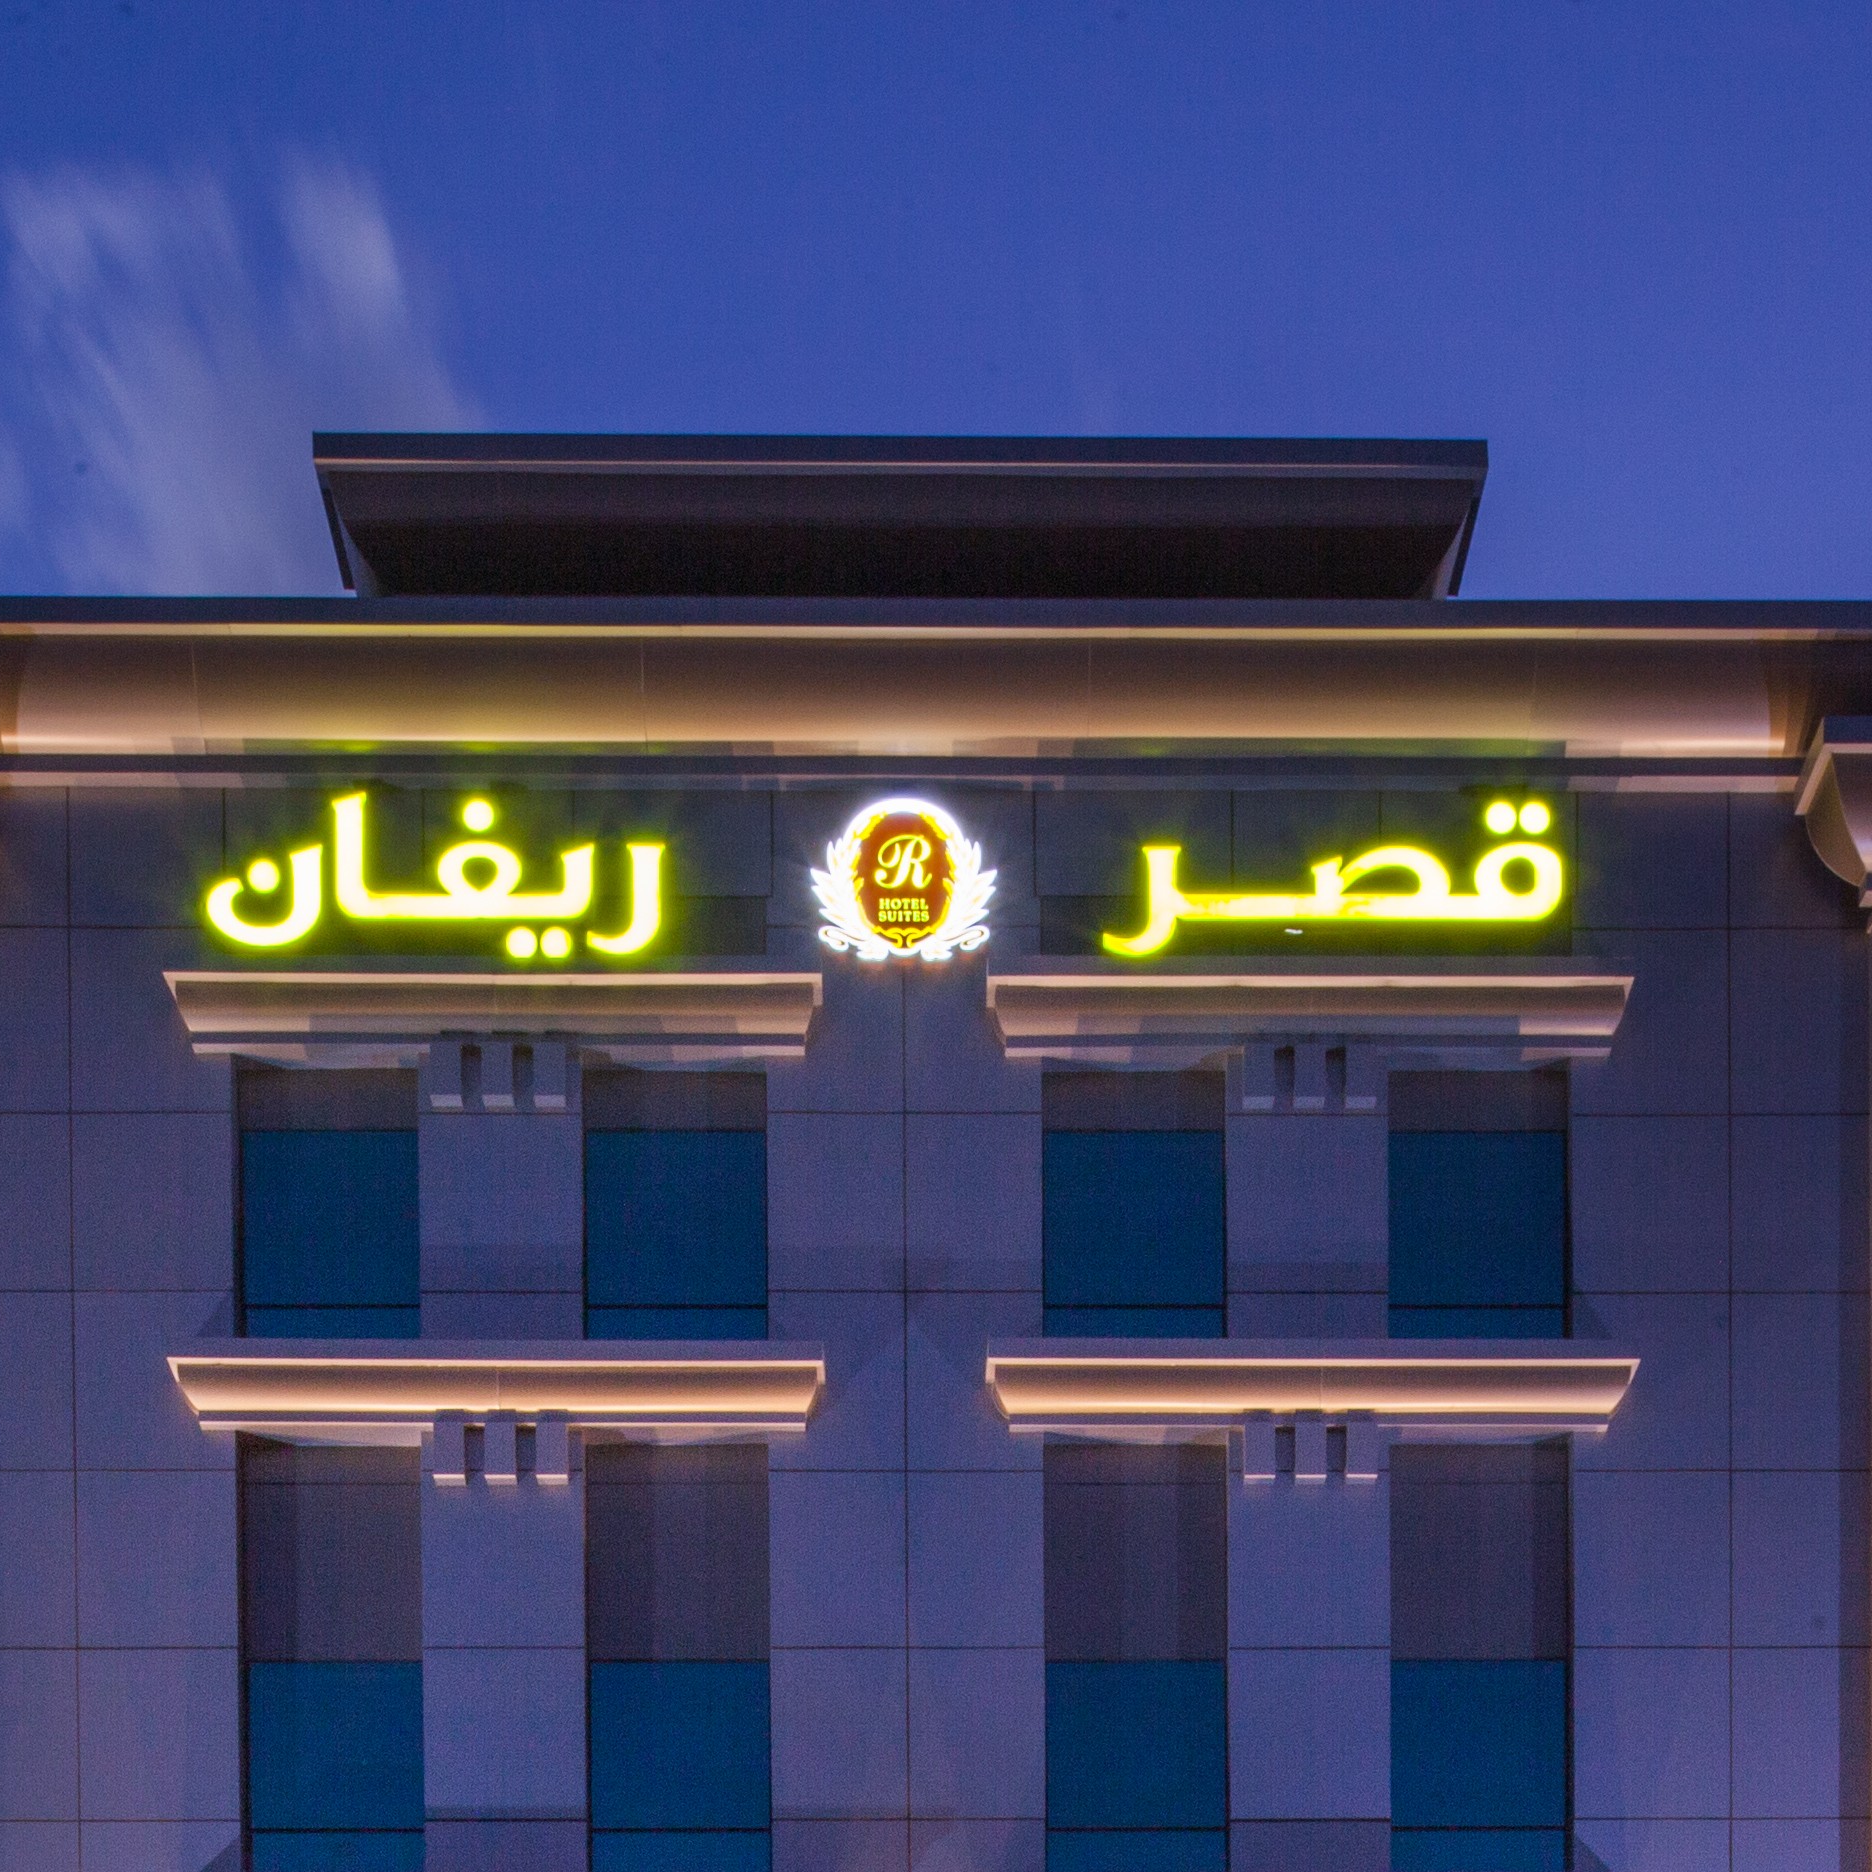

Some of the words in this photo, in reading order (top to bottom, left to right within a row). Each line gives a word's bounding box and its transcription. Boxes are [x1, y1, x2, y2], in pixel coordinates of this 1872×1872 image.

[204, 790, 667, 962] ريفان
[874, 833, 933, 890] R
[1101, 798, 1565, 959] قصر
[878, 898, 930, 911] HOTEL
[878, 911, 931, 924] SUITES
